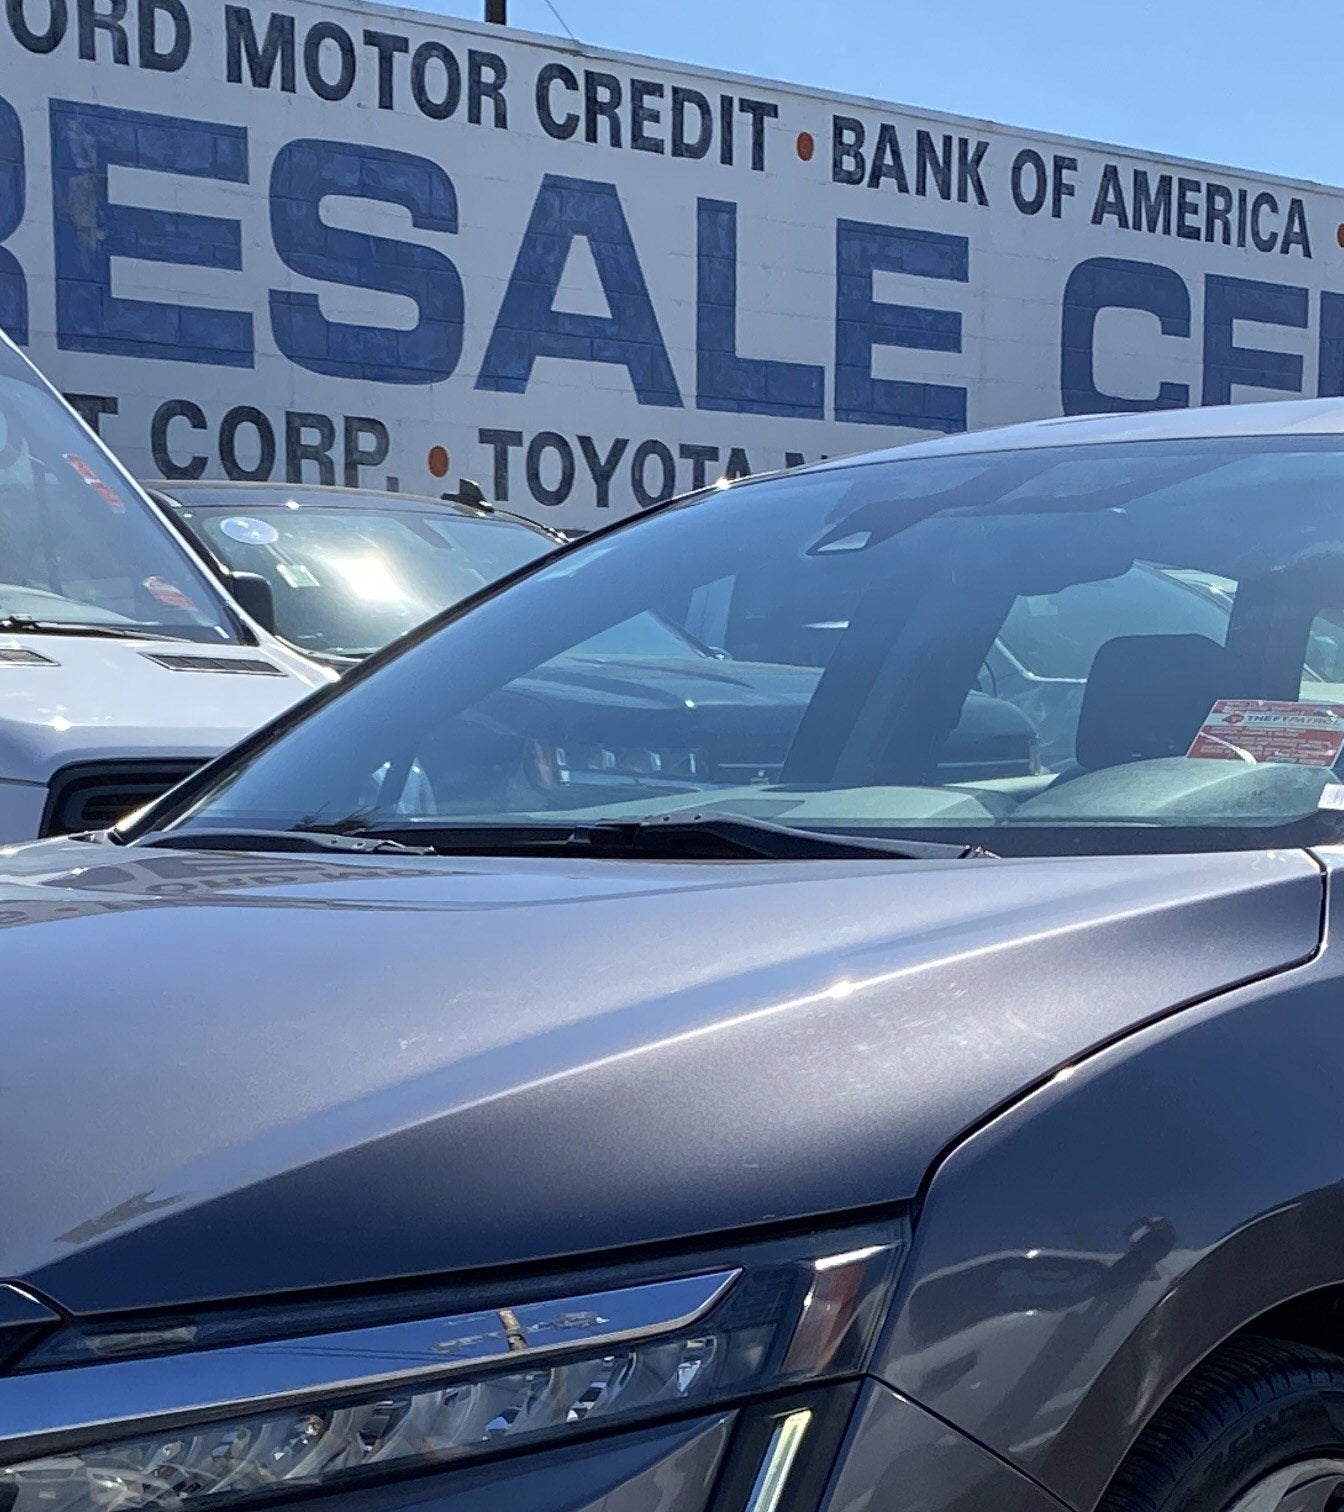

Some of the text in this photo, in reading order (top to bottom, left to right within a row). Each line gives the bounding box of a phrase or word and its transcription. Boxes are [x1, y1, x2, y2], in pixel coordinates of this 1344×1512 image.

[224, 4, 509, 129] MOTOR
[536, 62, 779, 171] CREDIT
[832, 114, 990, 207] BANK
[1011, 149, 1078, 218] OF
[1091, 163, 1312, 259] AMERICA
[151, 399, 399, 493] CORP.
